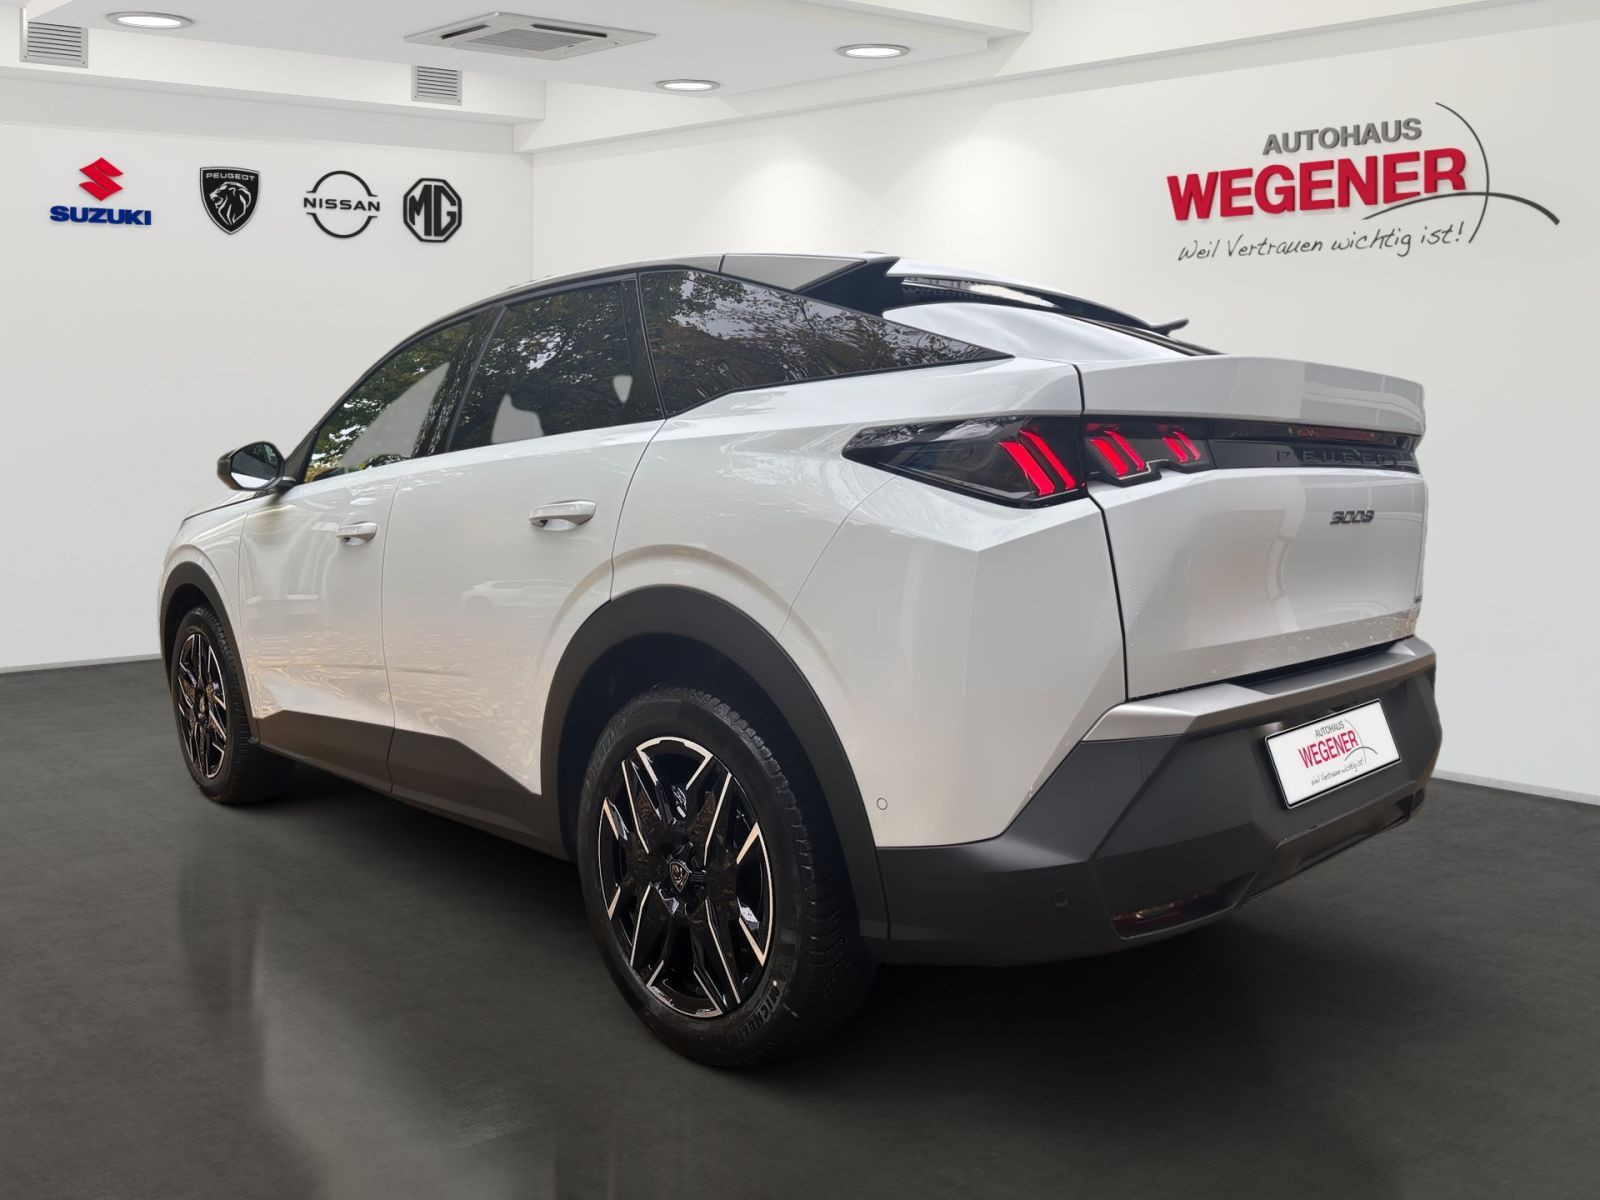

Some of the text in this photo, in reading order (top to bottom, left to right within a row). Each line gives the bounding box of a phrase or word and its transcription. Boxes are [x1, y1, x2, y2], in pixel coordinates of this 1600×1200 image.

[1262, 117, 1422, 156] AUTOHAUS
[205, 171, 256, 182] PEUGEOT
[1167, 147, 1467, 222] WEGENER
[49, 205, 152, 226] SUZUKI
[303, 196, 380, 212] NISSAN
[408, 183, 458, 238] MG
[1178, 220, 1465, 261] Weil Vertrauen wichtig ist!
[1330, 510, 1375, 525] 3008
[1314, 720, 1345, 738] AUTOHAUS
[1298, 729, 1359, 769] WEGENER
